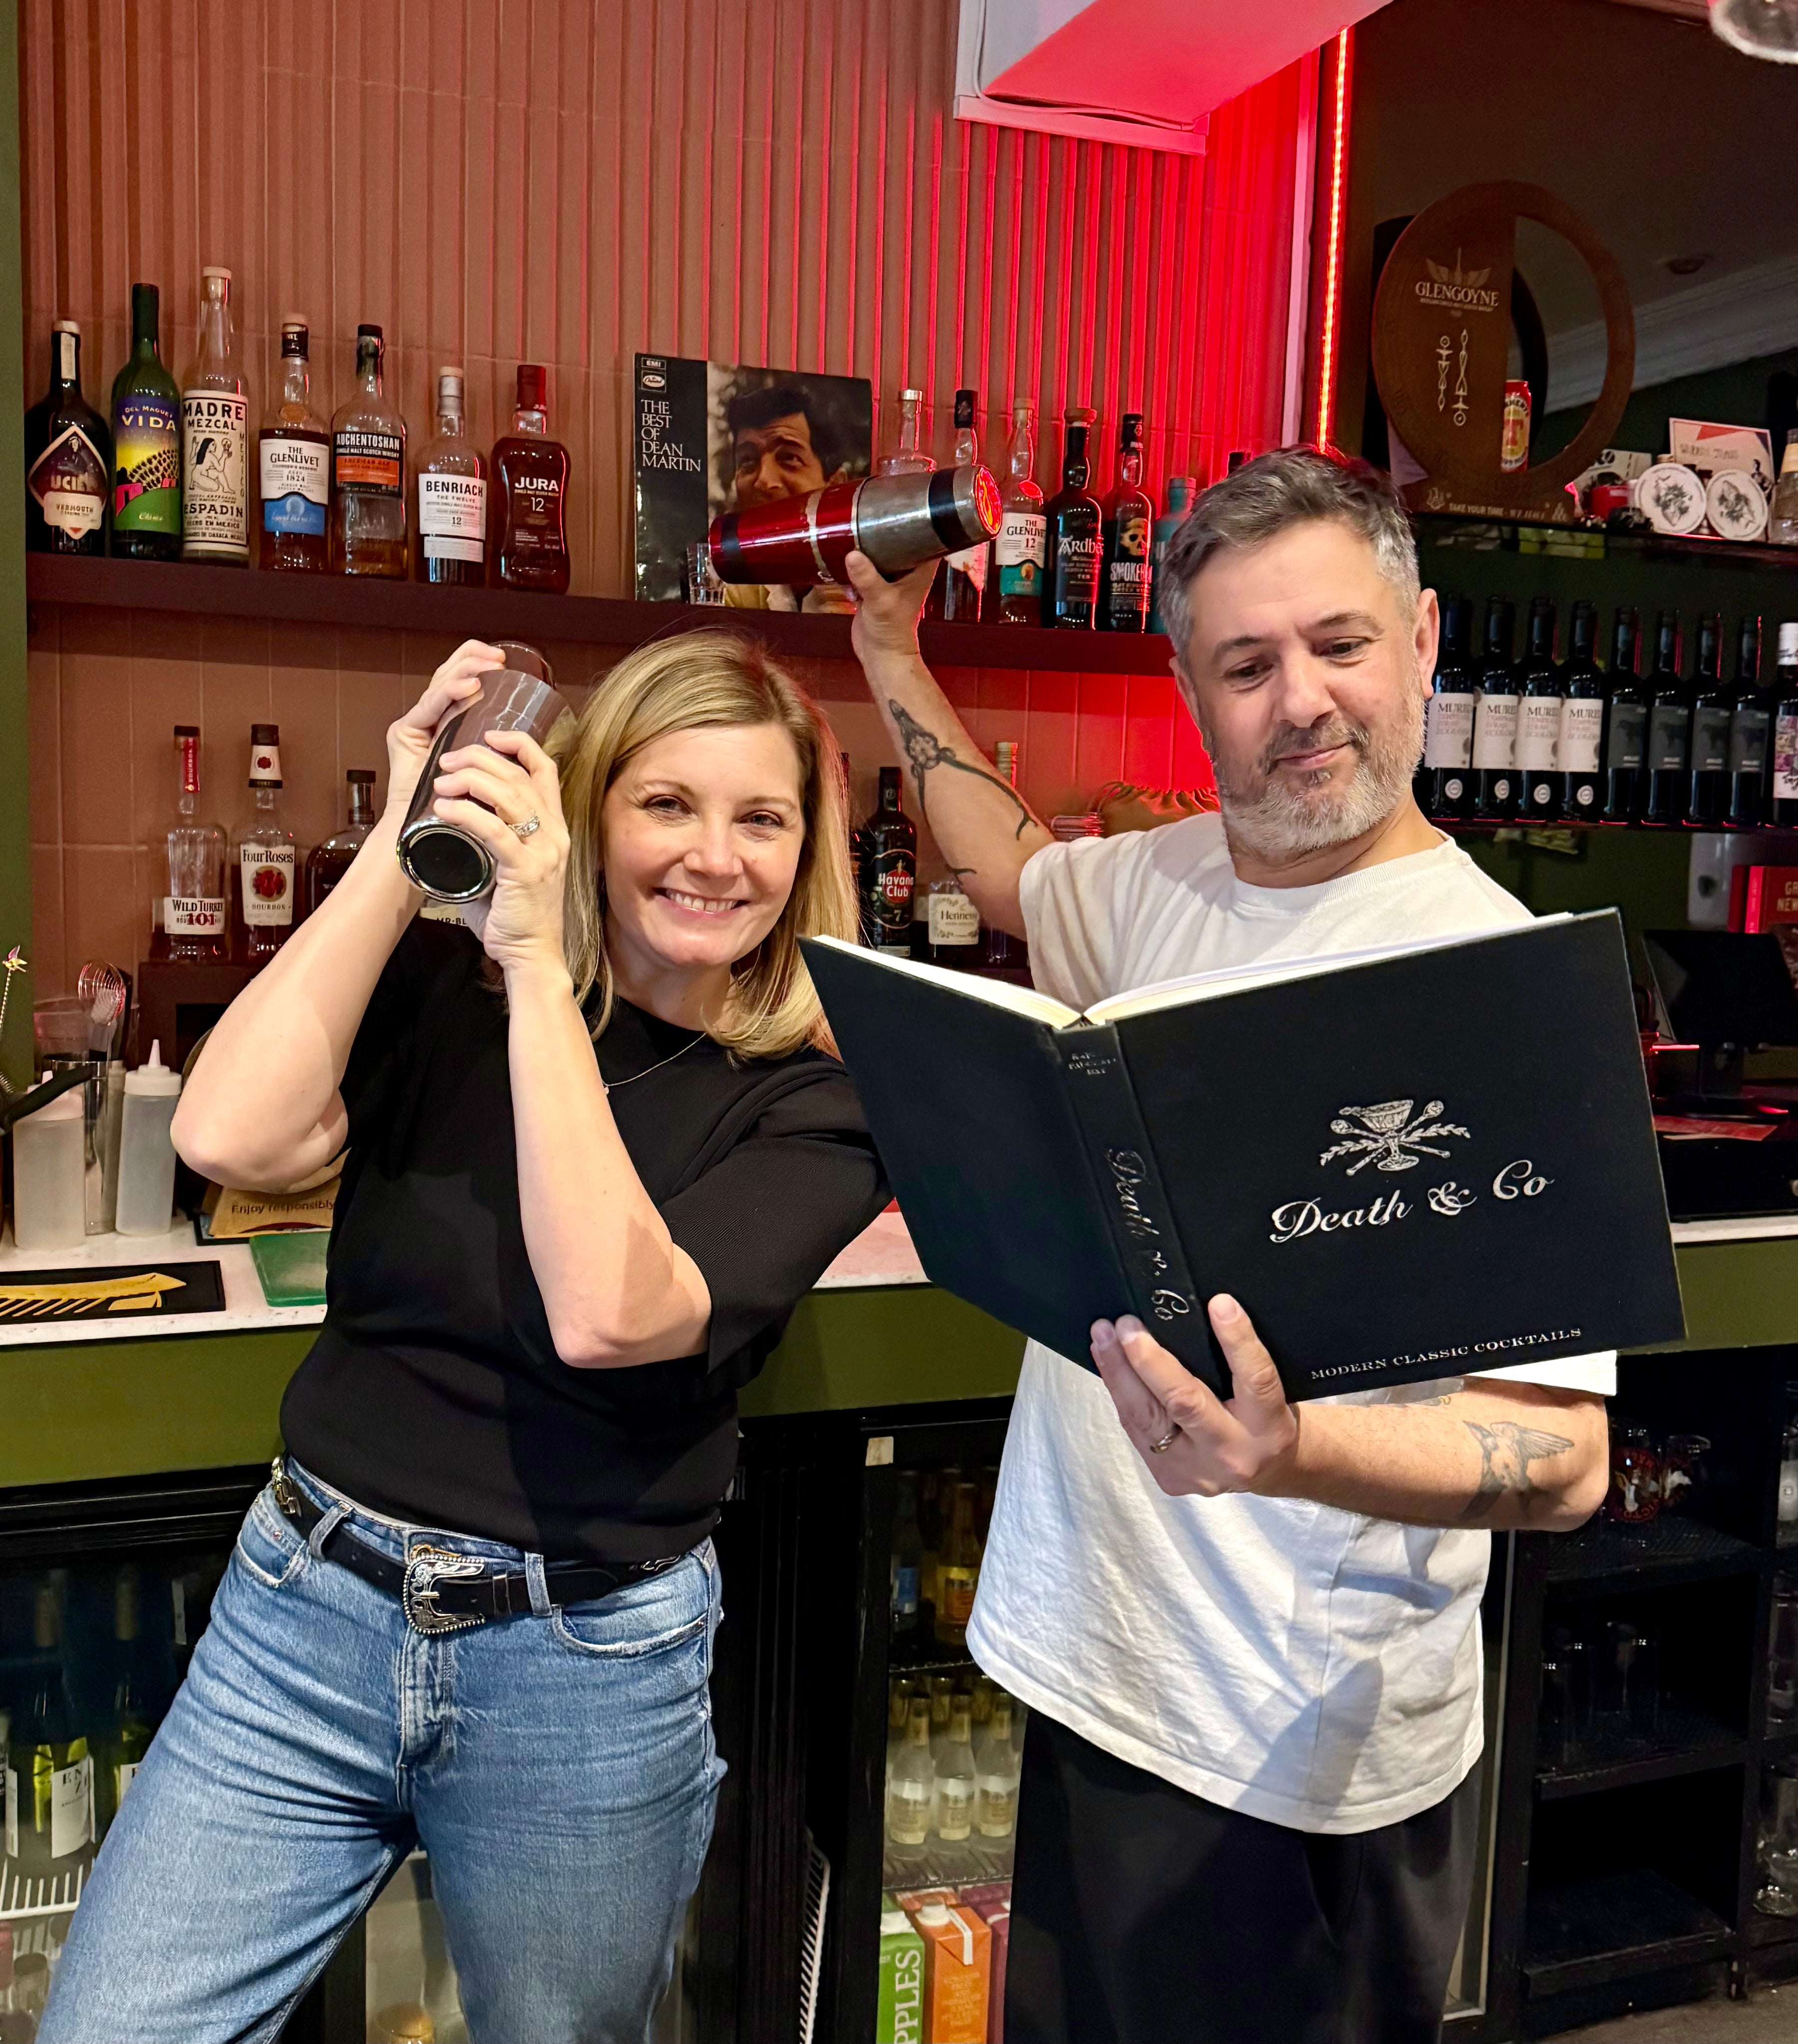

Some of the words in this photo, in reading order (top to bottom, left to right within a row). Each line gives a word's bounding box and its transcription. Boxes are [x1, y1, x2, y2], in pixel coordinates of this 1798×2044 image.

[1415, 281, 1499, 306] GLENGOYNE
[183, 402, 243, 421] MADRE
[641, 400, 670, 414] THE
[121, 415, 176, 432] VIDA
[188, 419, 236, 431] MEZCAL
[642, 413, 672, 428] BEST
[642, 427, 660, 440] OF
[336, 433, 400, 451] AUCHENTOSHAN
[643, 441, 682, 456] DEAN
[270, 453, 319, 467] GLENLIVET
[643, 454, 700, 471] MARTIN
[426, 481, 483, 498] BENRIACH
[515, 476, 559, 491] JURA
[56, 504, 94, 513] VERMOUTH
[184, 503, 243, 517] ESPADIN
[531, 497, 545, 511] 12
[452, 516, 462, 525] 12
[1025, 538, 1036, 548] 12
[243, 849, 265, 863] Four
[264, 850, 293, 863] Roses
[878, 873, 914, 886] Havana
[886, 886, 908, 897] Club
[172, 900, 198, 912] WILD
[187, 912, 215, 925] 101
[894, 909, 901, 922] 7
[231, 1204, 265, 1215] Enjoy
[268, 1199, 336, 1214] responsibly
[1270, 1189, 1413, 1243] Death
[1427, 1181, 1478, 1216] &
[1493, 1159, 1555, 1200] Co
[1105, 1147, 1159, 1240] Death
[1151, 1289, 1190, 1321] Co
[1311, 1358, 1388, 1379] MODERN
[1393, 1346, 1469, 1366] CLASSIC
[1474, 1328, 1582, 1353] COCKTAILS
